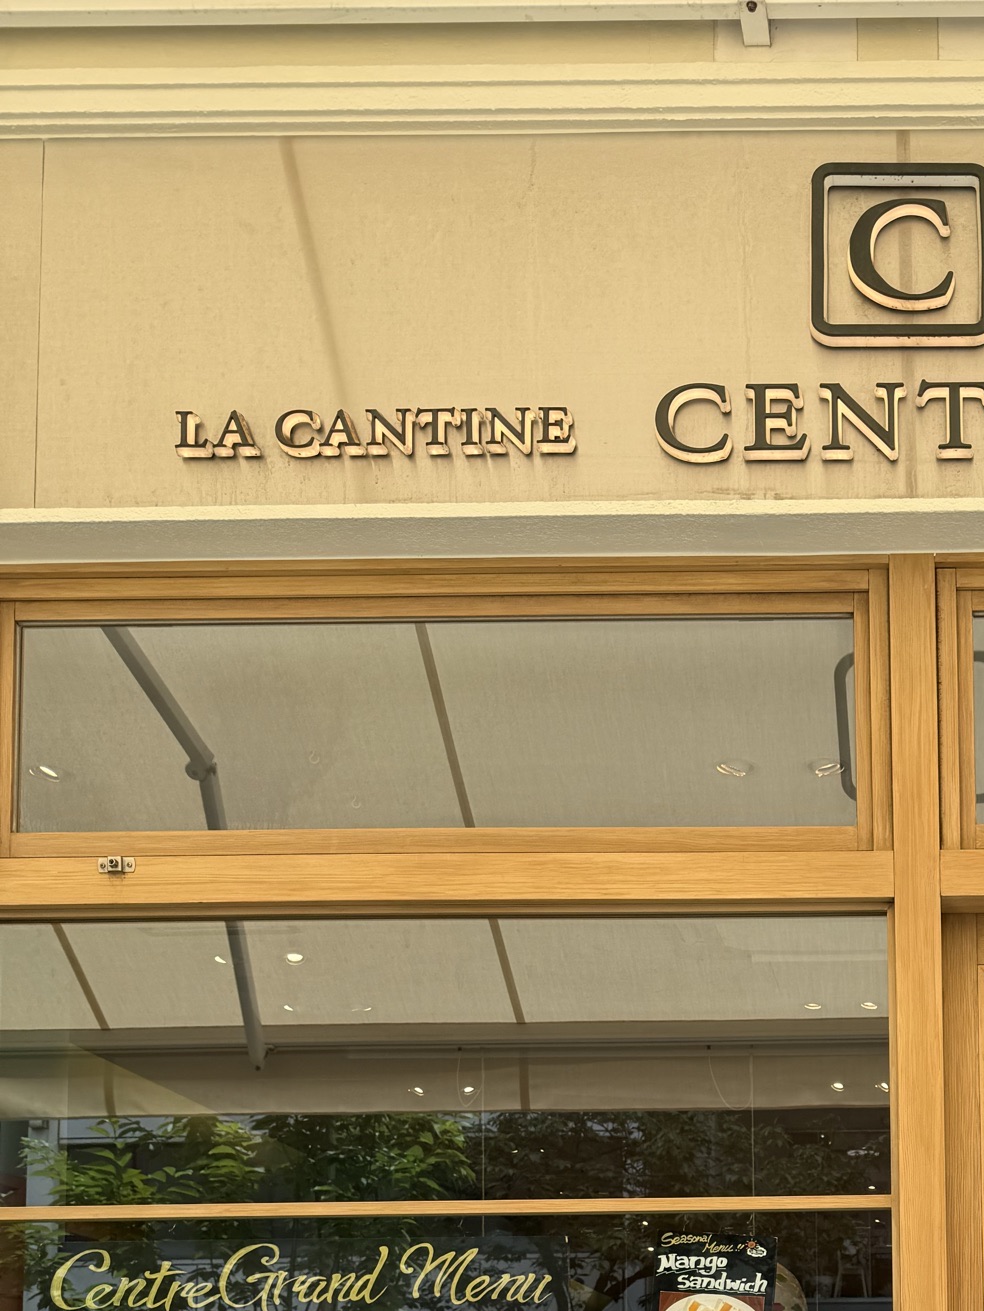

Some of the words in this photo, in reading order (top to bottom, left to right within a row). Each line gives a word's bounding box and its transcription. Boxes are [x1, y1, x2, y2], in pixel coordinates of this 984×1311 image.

[847, 198, 955, 311] C
[174, 408, 262, 458] LA
[274, 406, 577, 458] CANTINE
[657, 1253, 728, 1275] Mango
[660, 1231, 712, 1247] Seasonal
[49, 1247, 222, 1311] Centre
[399, 1241, 554, 1306] Menu
